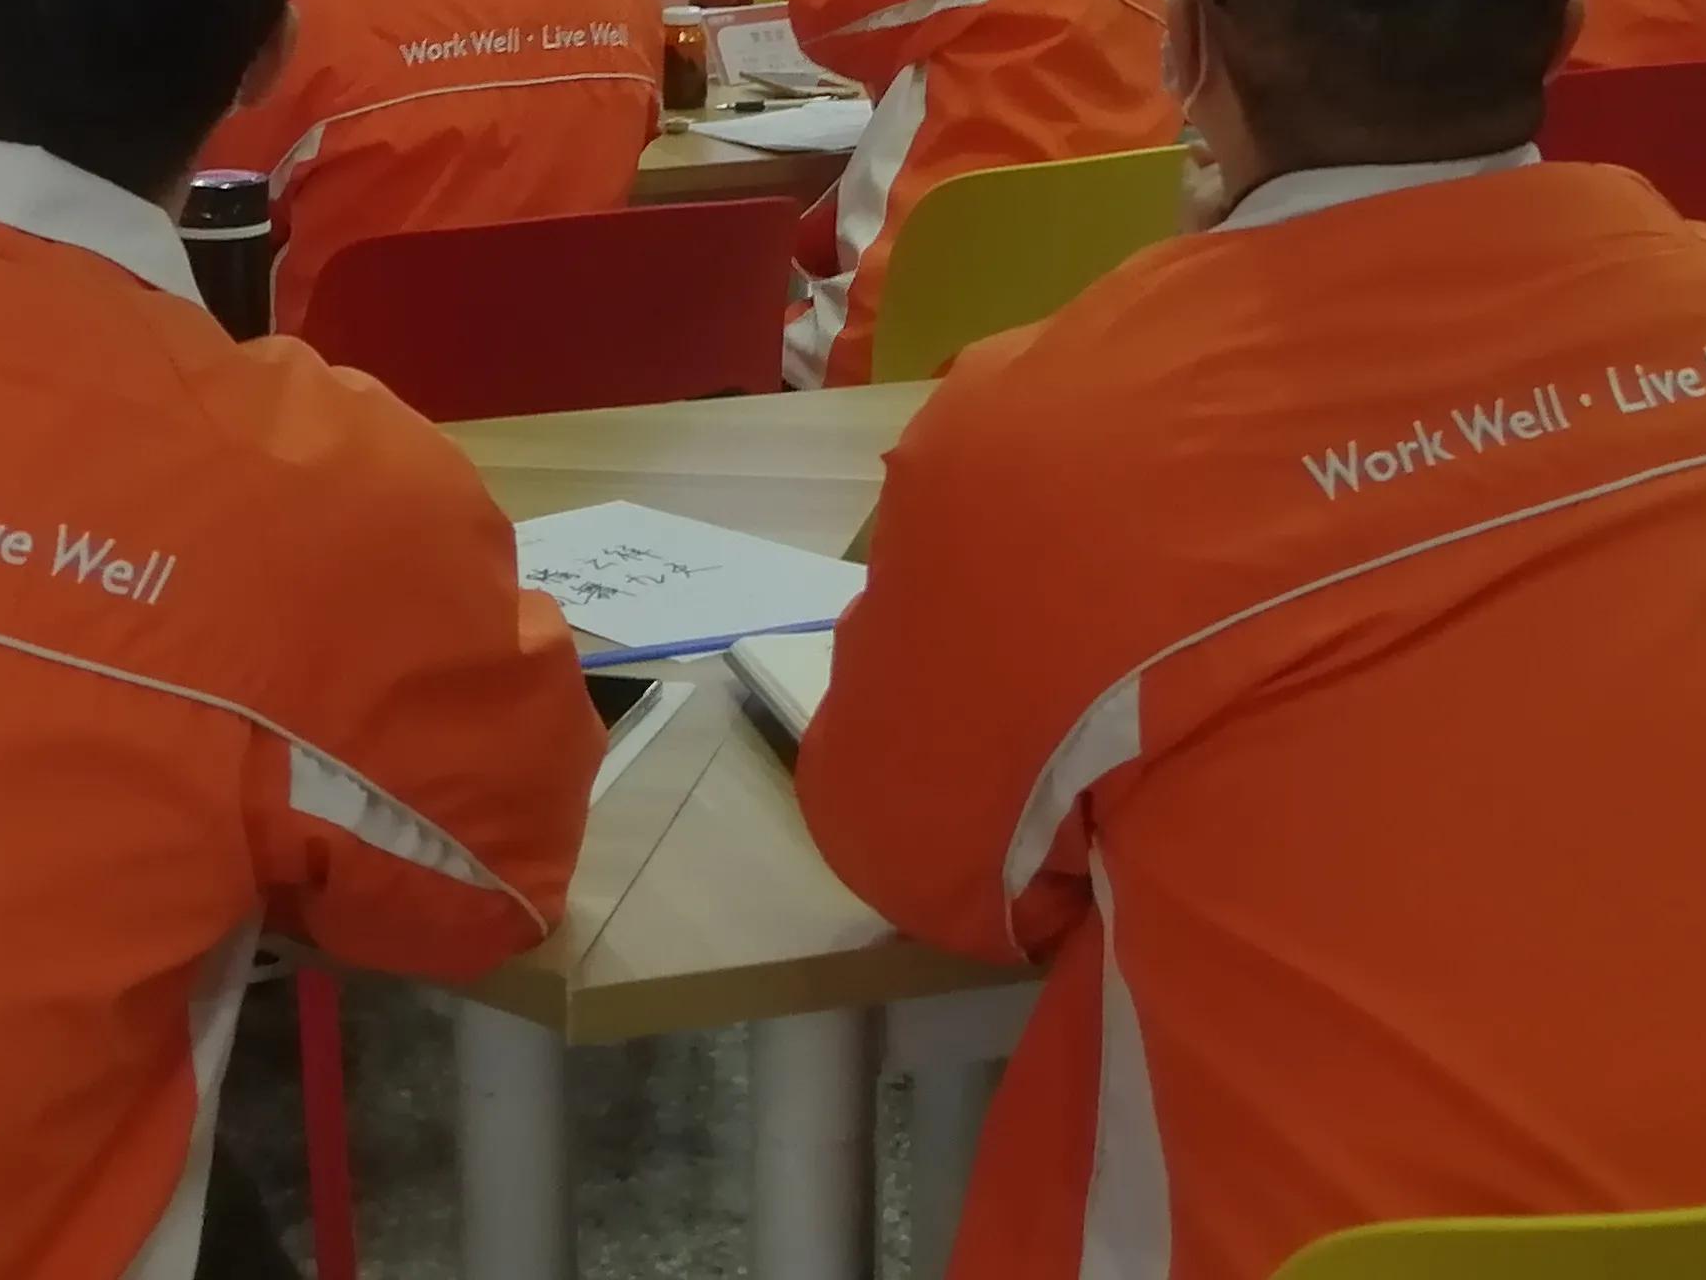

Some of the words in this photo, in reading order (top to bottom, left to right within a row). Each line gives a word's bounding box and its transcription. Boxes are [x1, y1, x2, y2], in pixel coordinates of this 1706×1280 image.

[399, 32, 468, 67] Work
[469, 26, 520, 55] Well
[542, 23, 585, 51] Live
[1301, 419, 1455, 501] Work
[1451, 382, 1571, 454] Well
[50, 522, 177, 605] Well
